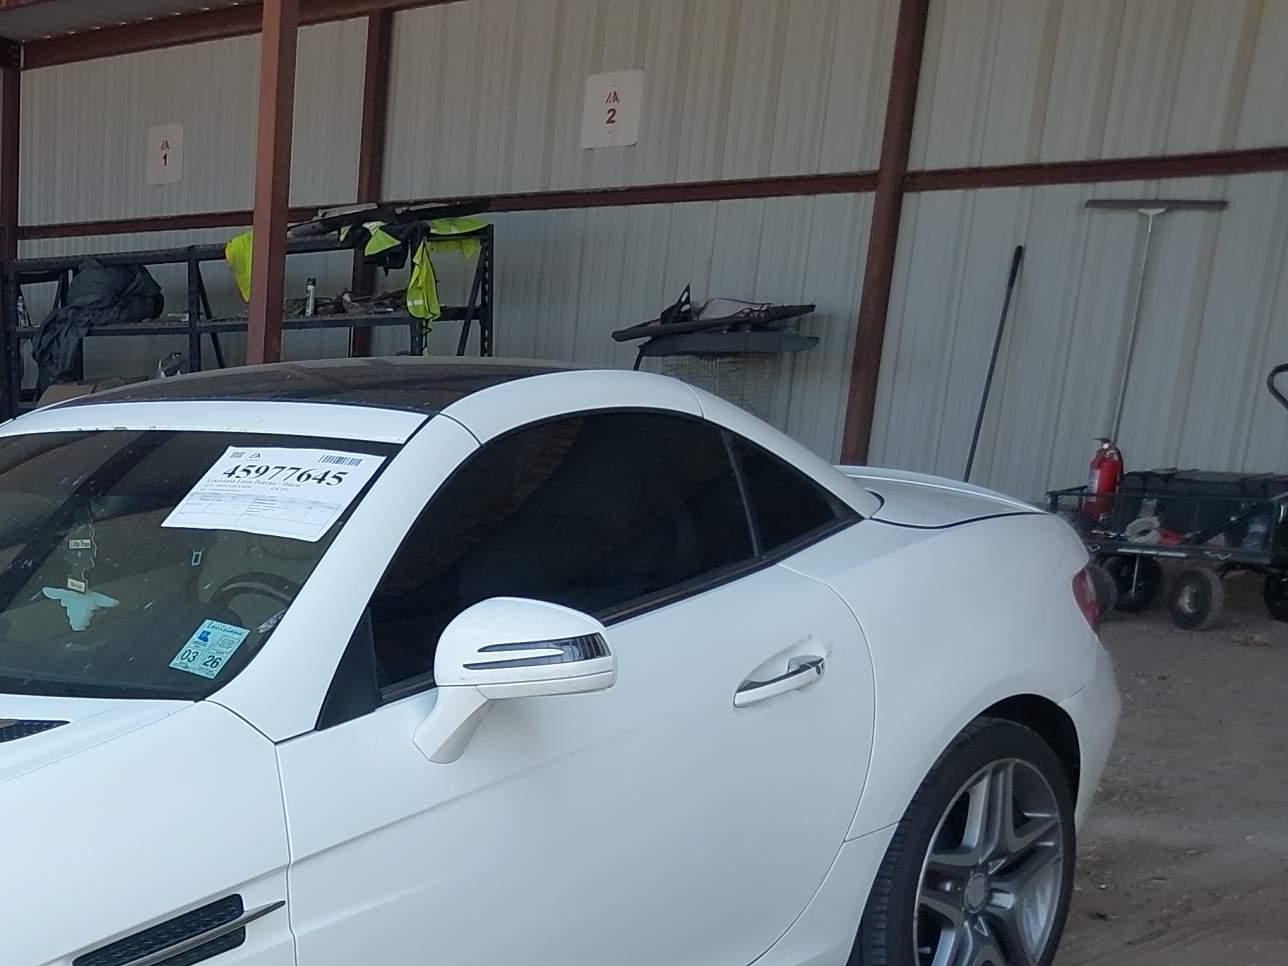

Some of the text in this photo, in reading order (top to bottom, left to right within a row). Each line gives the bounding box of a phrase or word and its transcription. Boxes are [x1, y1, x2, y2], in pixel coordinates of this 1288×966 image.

[606, 108, 617, 124] 2
[162, 152, 168, 167] 1
[223, 464, 349, 486] 45977645
[180, 649, 199, 663] 03
[202, 654, 222, 669] 26
